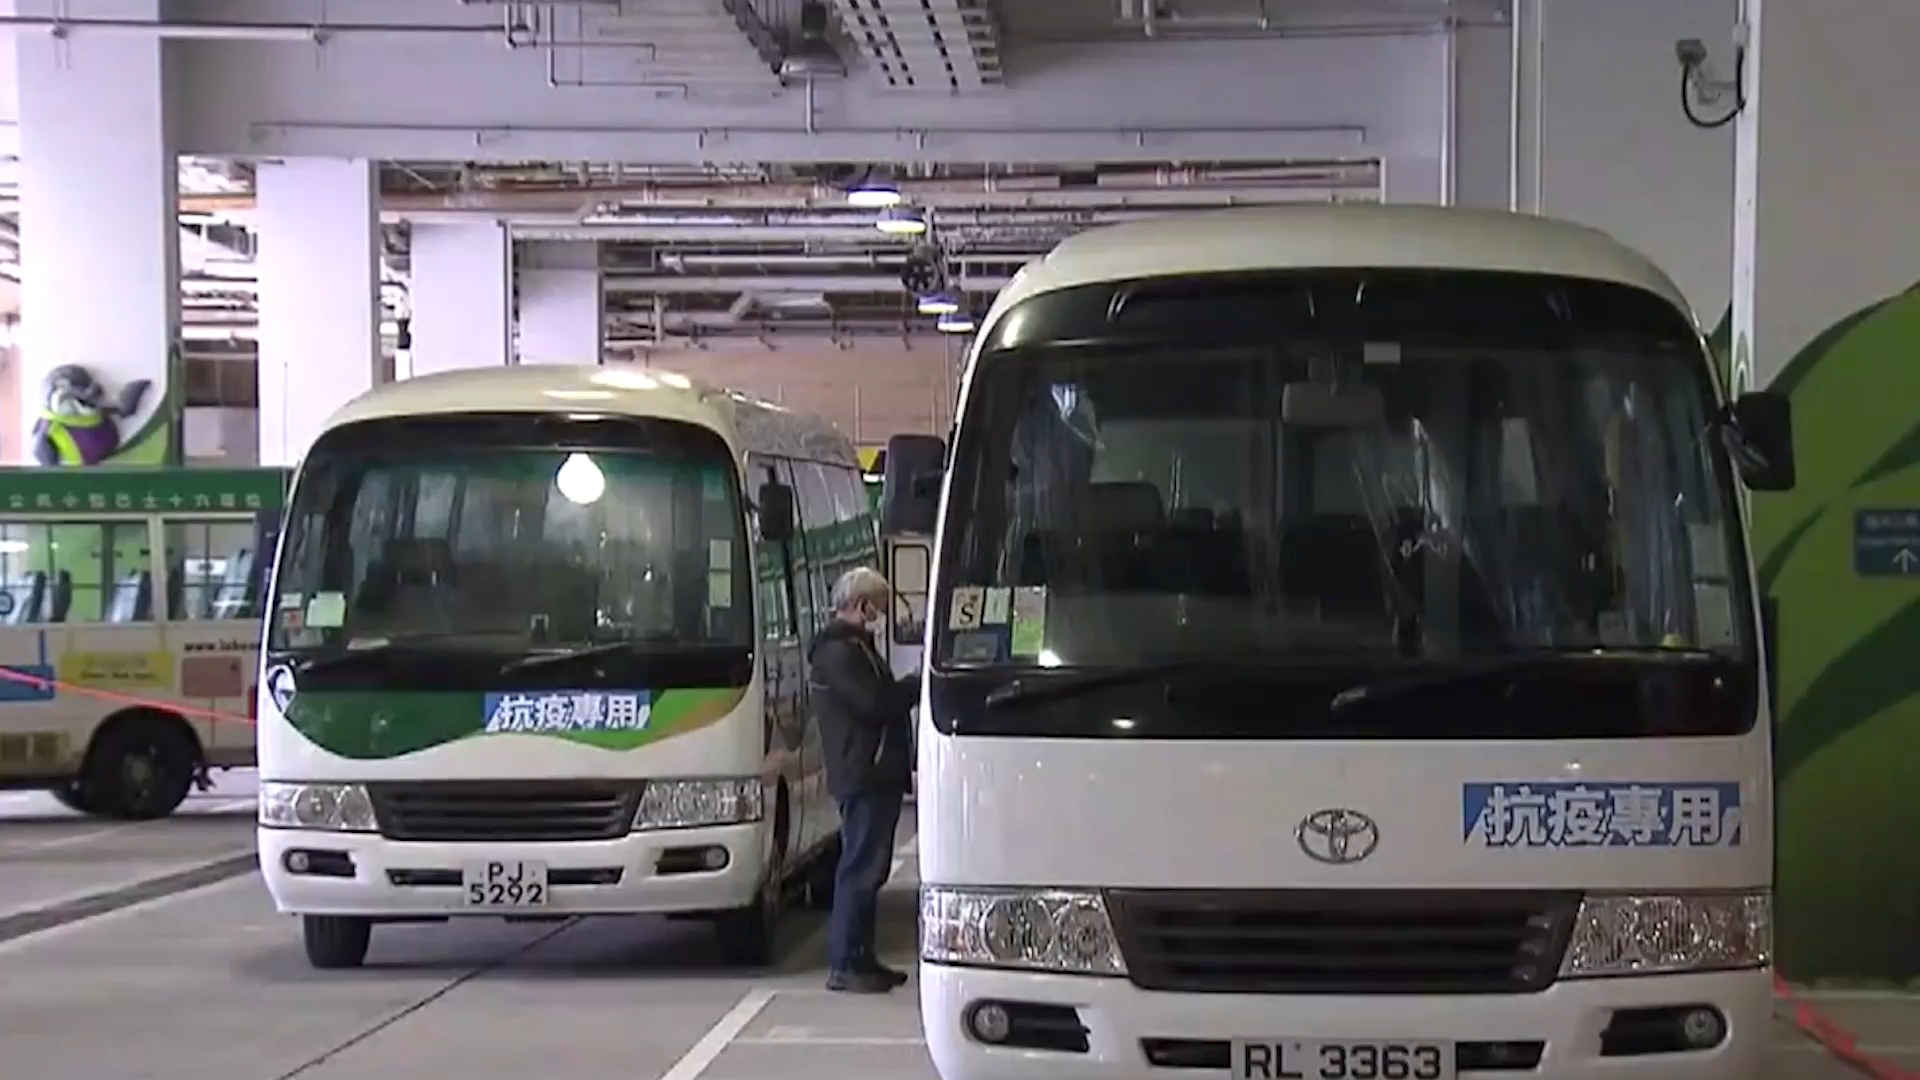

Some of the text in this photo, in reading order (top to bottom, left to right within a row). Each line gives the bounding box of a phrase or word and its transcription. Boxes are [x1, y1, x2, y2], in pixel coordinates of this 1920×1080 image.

[500, 693, 638, 731] 抗疫專用
[1487, 785, 1719, 848] 抗疫專用
[489, 862, 523, 884] PJ
[470, 883, 542, 904] 5292
[1245, 1043, 1441, 1079] RL 3363
